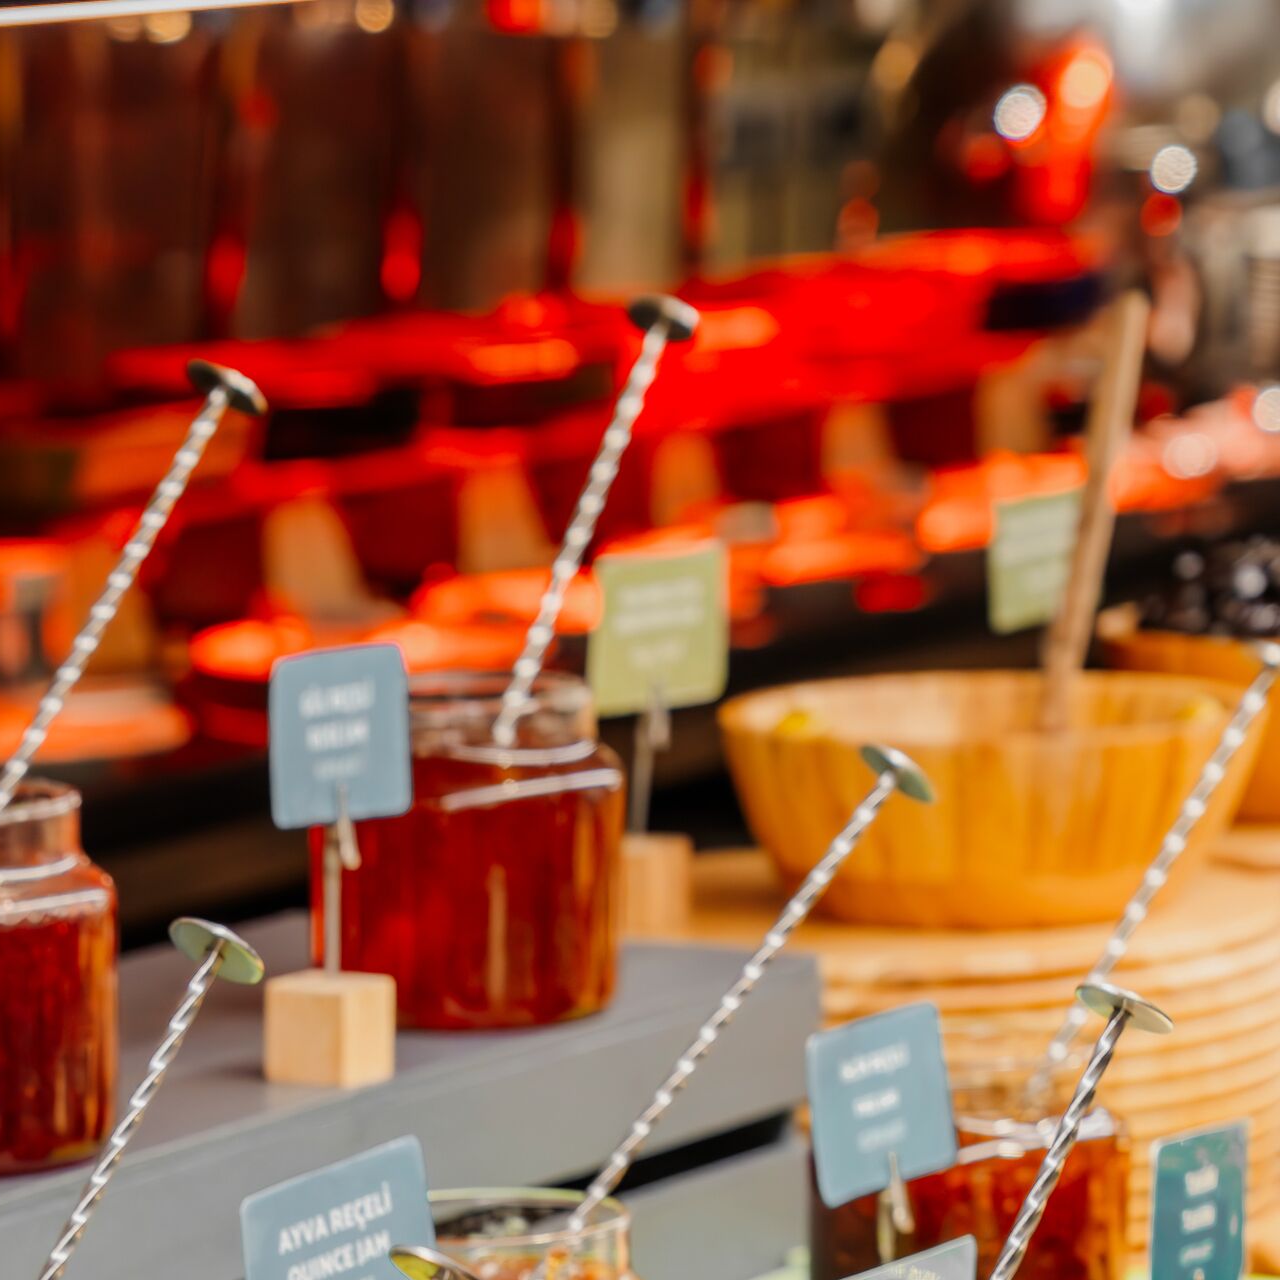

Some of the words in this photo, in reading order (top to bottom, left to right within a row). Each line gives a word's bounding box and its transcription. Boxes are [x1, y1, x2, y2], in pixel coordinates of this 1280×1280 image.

[278, 1216, 329, 1255] AYVA
[329, 1181, 392, 1230] REÇELİ
[356, 1230, 391, 1265] JAM
